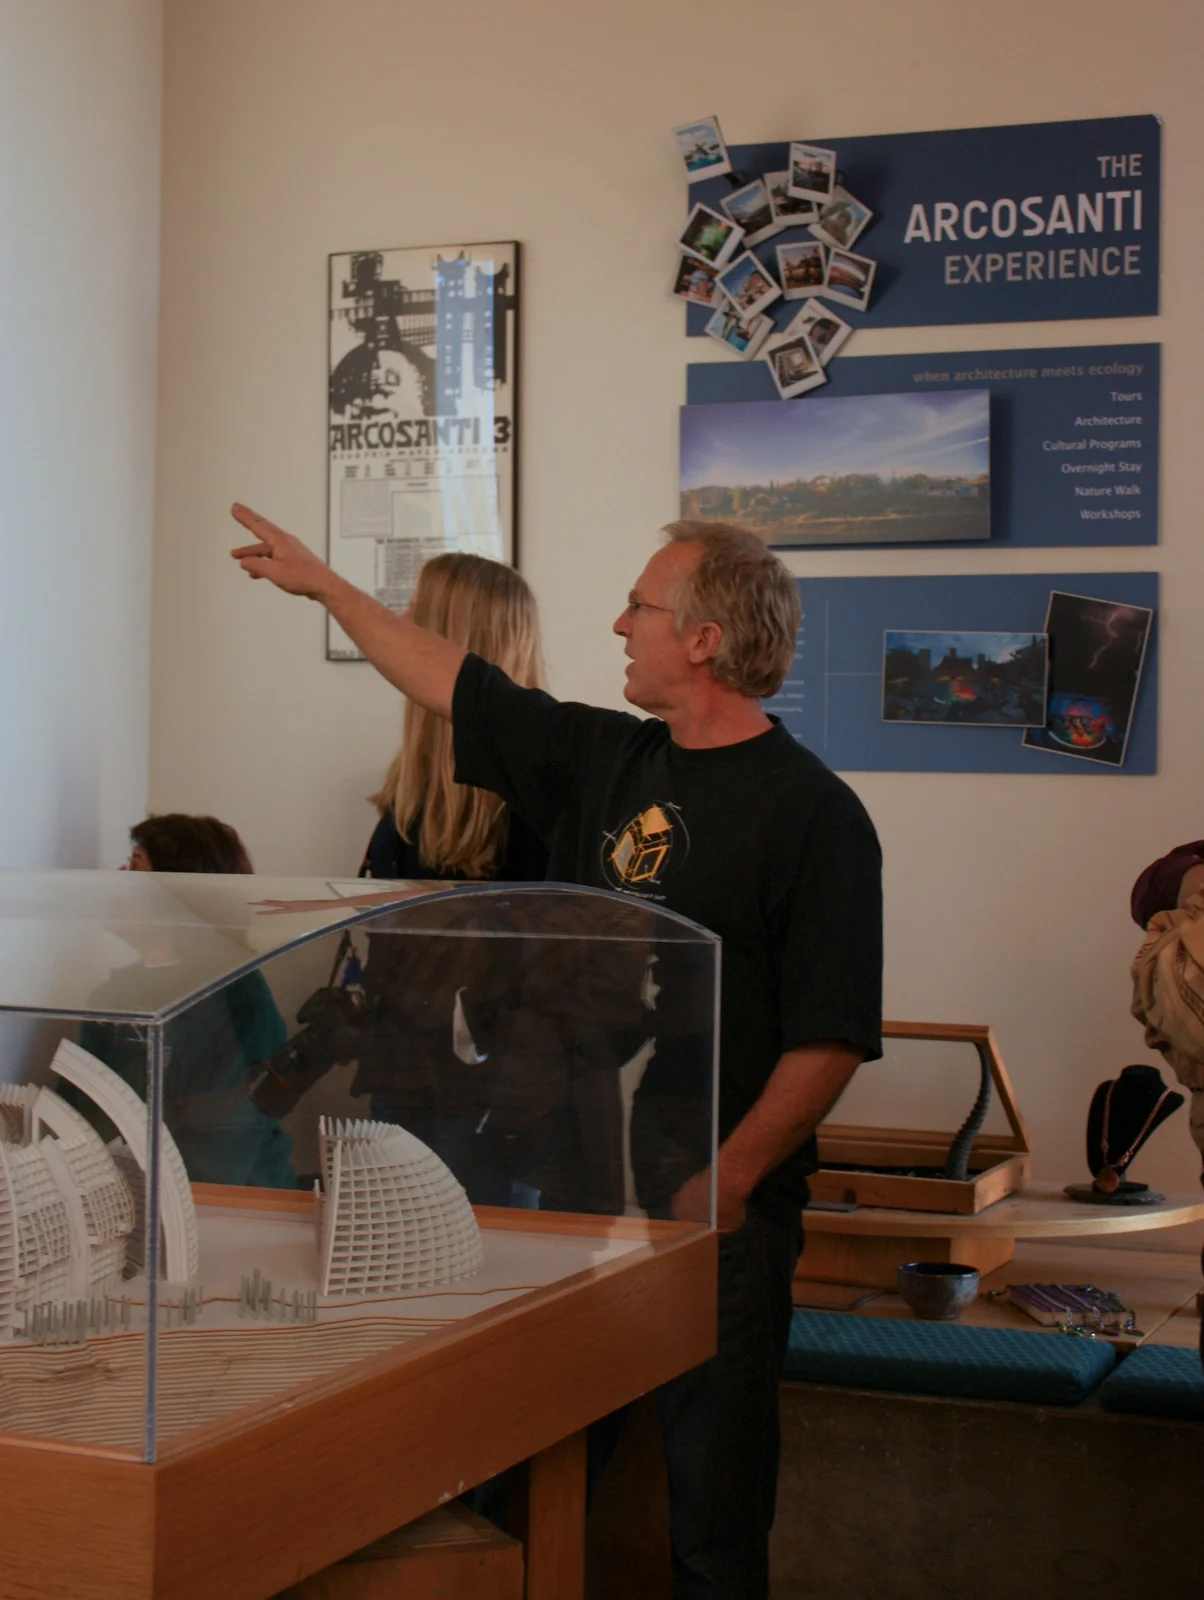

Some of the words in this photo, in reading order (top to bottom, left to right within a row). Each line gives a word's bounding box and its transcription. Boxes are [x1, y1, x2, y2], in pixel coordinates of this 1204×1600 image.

[1097, 153, 1143, 179] THE
[903, 189, 1143, 244] ARCOSANTI
[944, 244, 1142, 285] EXPERIENCE
[912, 370, 950, 383] when
[954, 367, 1037, 382] architecture
[1042, 365, 1084, 378] meets
[1089, 362, 1144, 378] ecology
[1110, 391, 1143, 403] Tours
[1075, 415, 1143, 427] Architecture
[330, 418, 480, 451] ARCOSANTI
[494, 416, 512, 443] 3
[1042, 439, 1086, 452] Cultural
[1090, 438, 1142, 452] Programs
[1061, 462, 1115, 476] Overnight
[1118, 461, 1142, 474] Stay
[1075, 486, 1113, 497] Nature
[1115, 484, 1142, 495] Walk
[1080, 509, 1141, 521] Workshops
